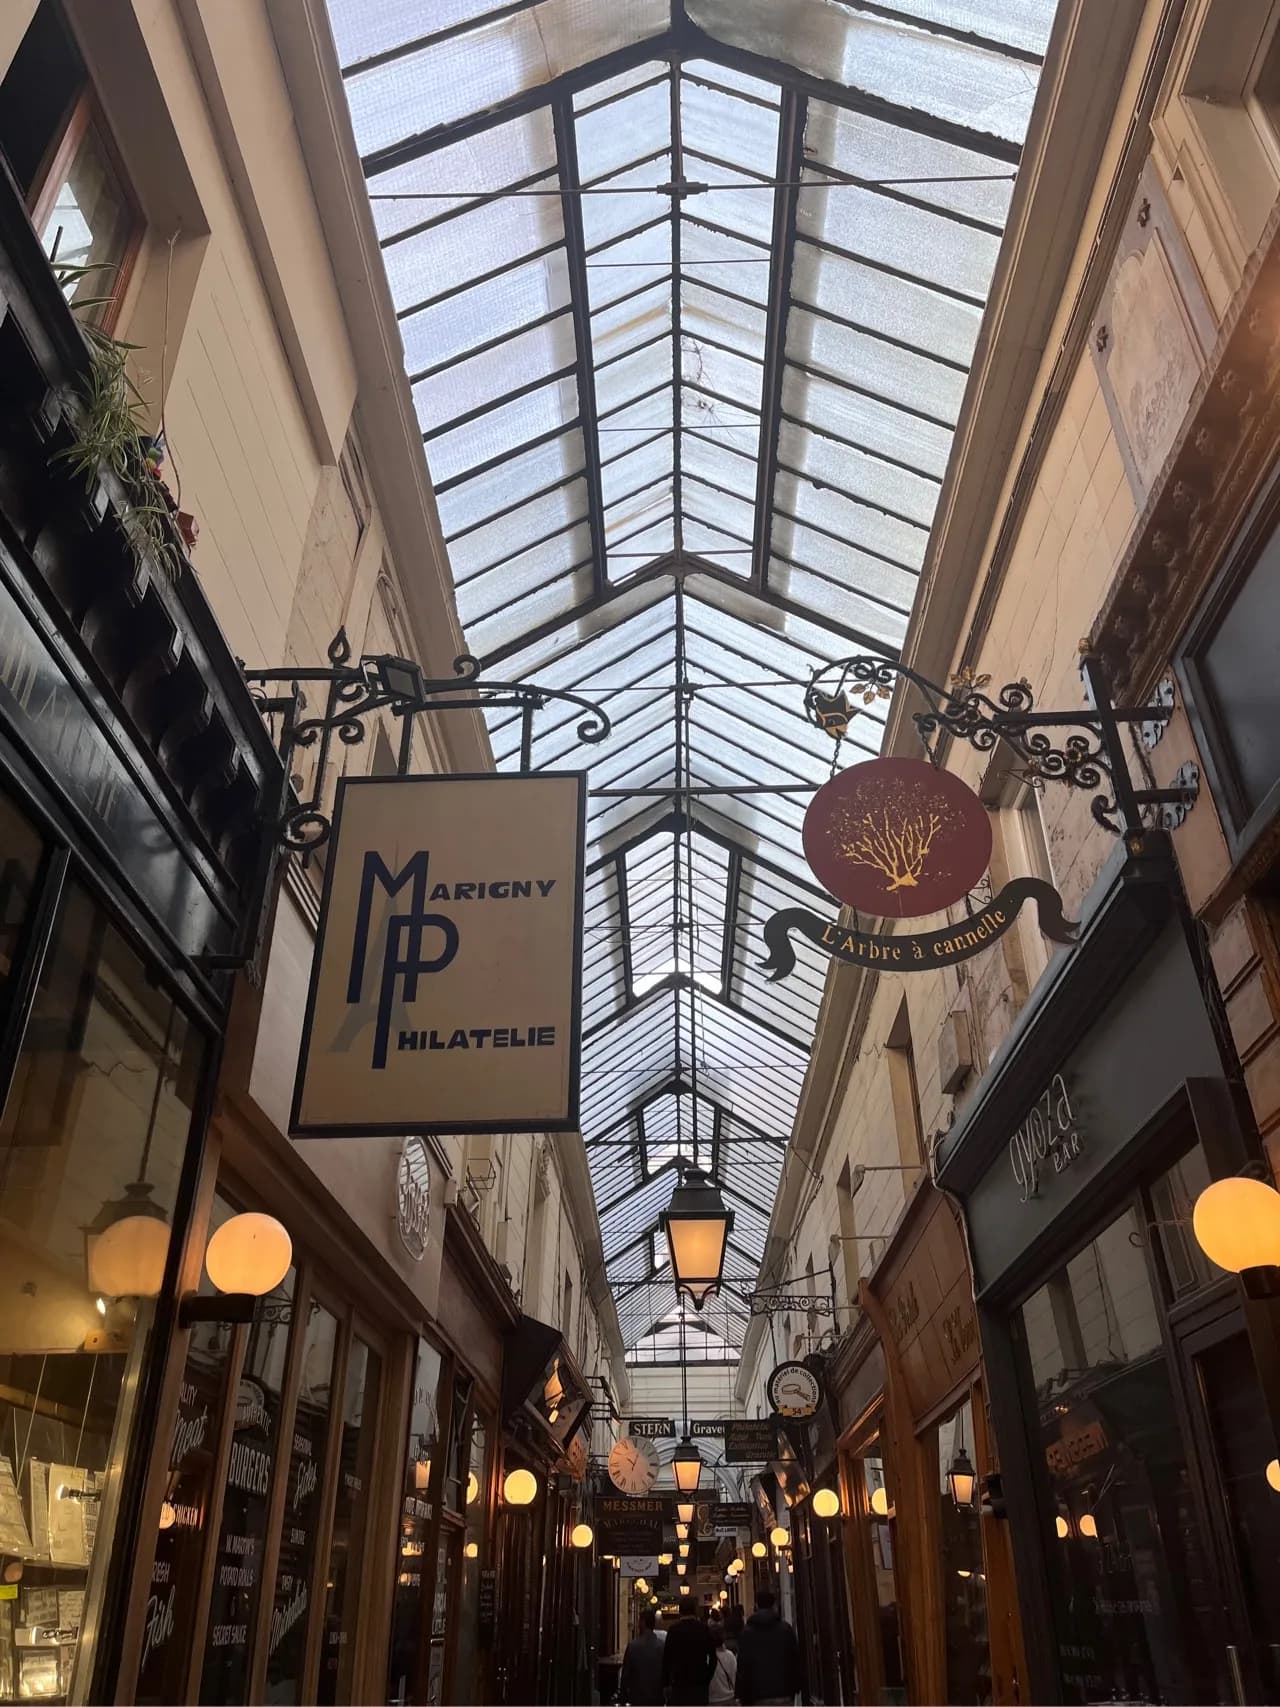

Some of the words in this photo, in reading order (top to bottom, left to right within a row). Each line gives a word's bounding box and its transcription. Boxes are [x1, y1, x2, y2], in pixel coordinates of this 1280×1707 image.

[821, 927, 901, 960] L'Arbre
[912, 940, 925, 959] à
[933, 909, 1006, 958] cannelle
[1009, 1073, 1077, 1203] gyoza
[1053, 1133, 1080, 1173] BAR
[633, 1422, 671, 1435] STERN
[228, 1441, 271, 1497] BURGERS
[602, 1500, 663, 1512] MESSMER
[152, 1561, 171, 1584] RESH
